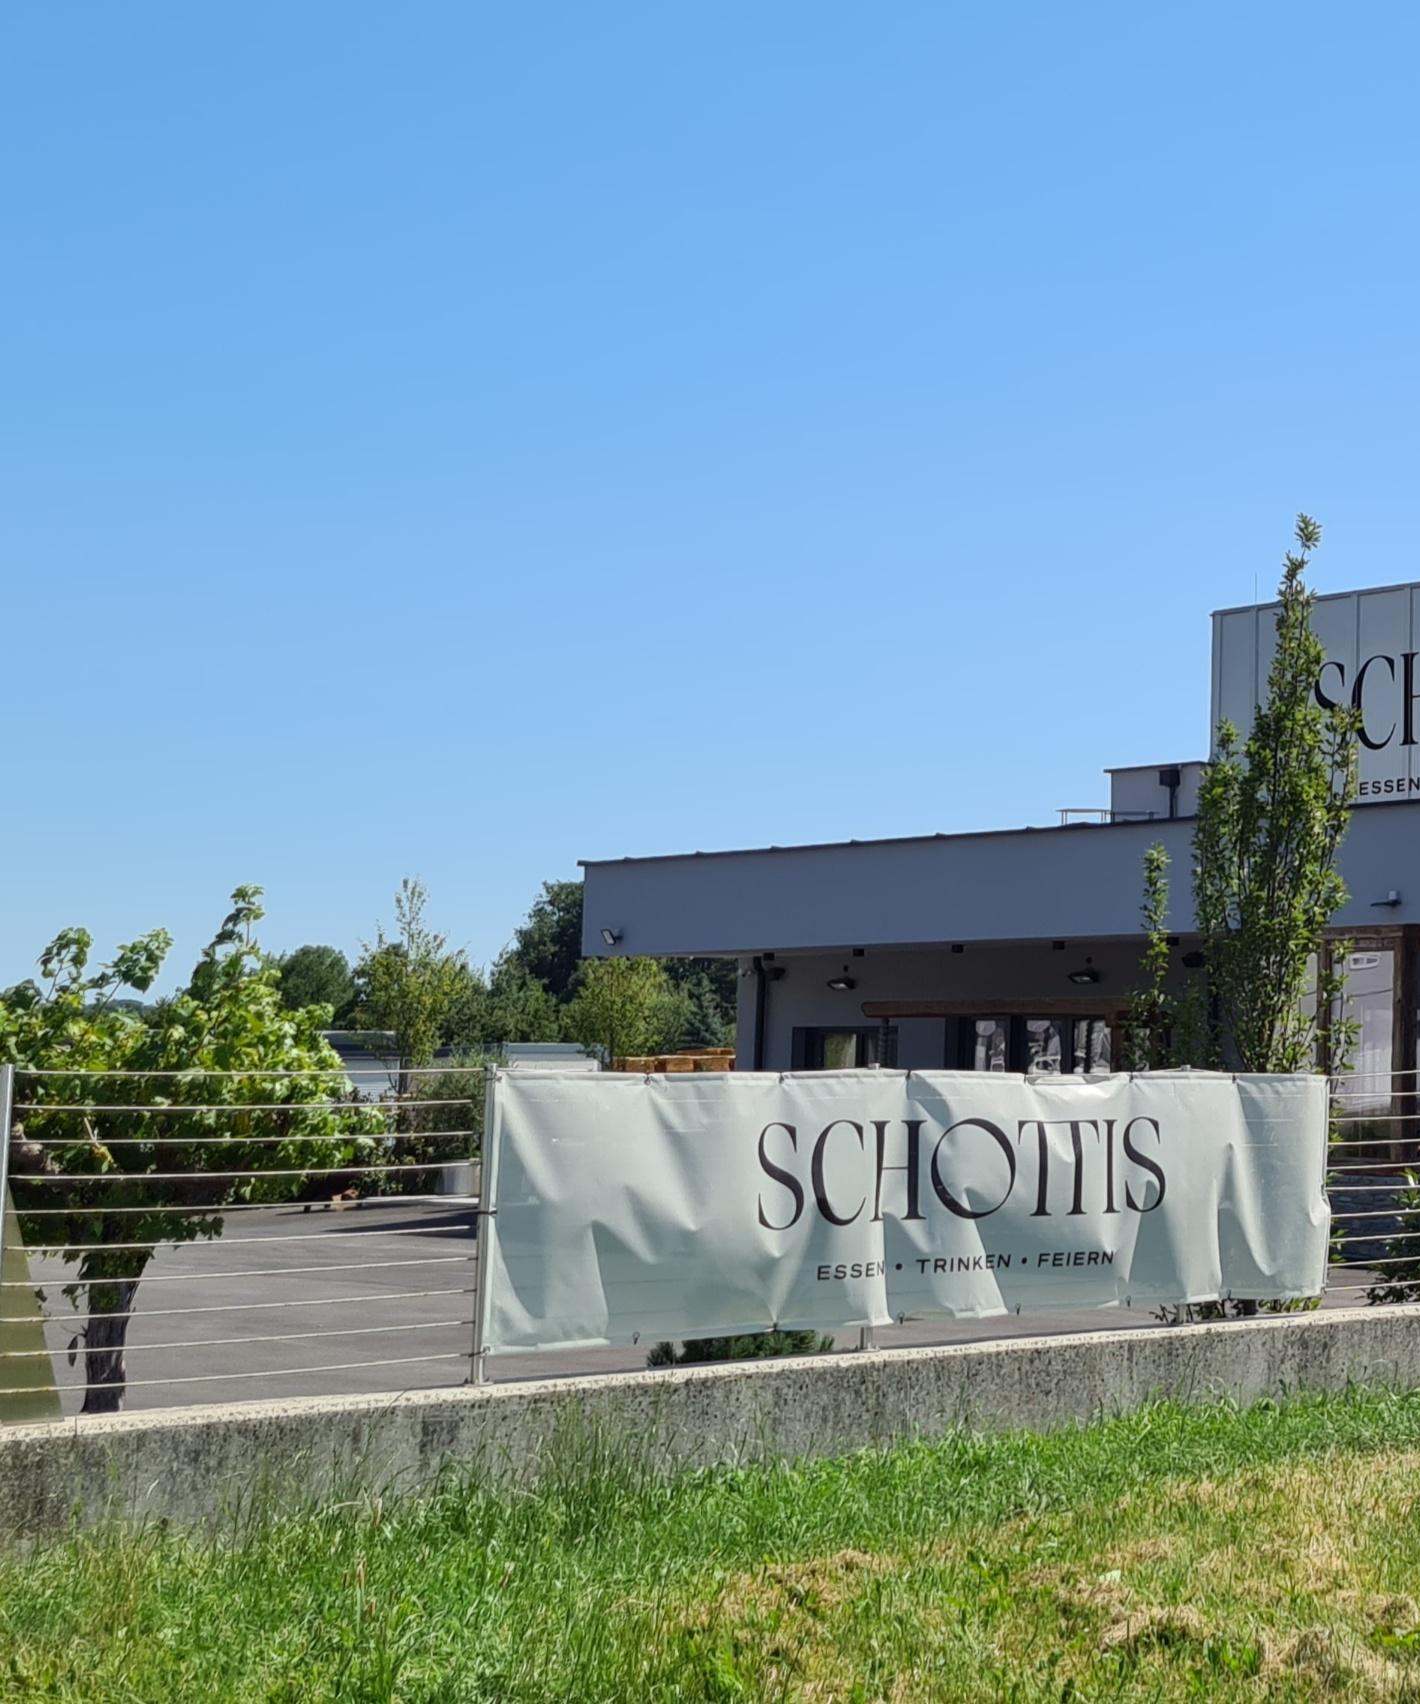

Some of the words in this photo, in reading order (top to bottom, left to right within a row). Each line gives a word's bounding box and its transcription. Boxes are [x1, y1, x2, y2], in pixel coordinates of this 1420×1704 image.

[1359, 777, 1420, 796] ESSEN
[758, 1116, 1166, 1231] SCHOTTIS
[816, 1260, 885, 1281] ESSEN
[915, 1253, 1012, 1275] TRINKEN
[1037, 1250, 1115, 1268] FEIERN
